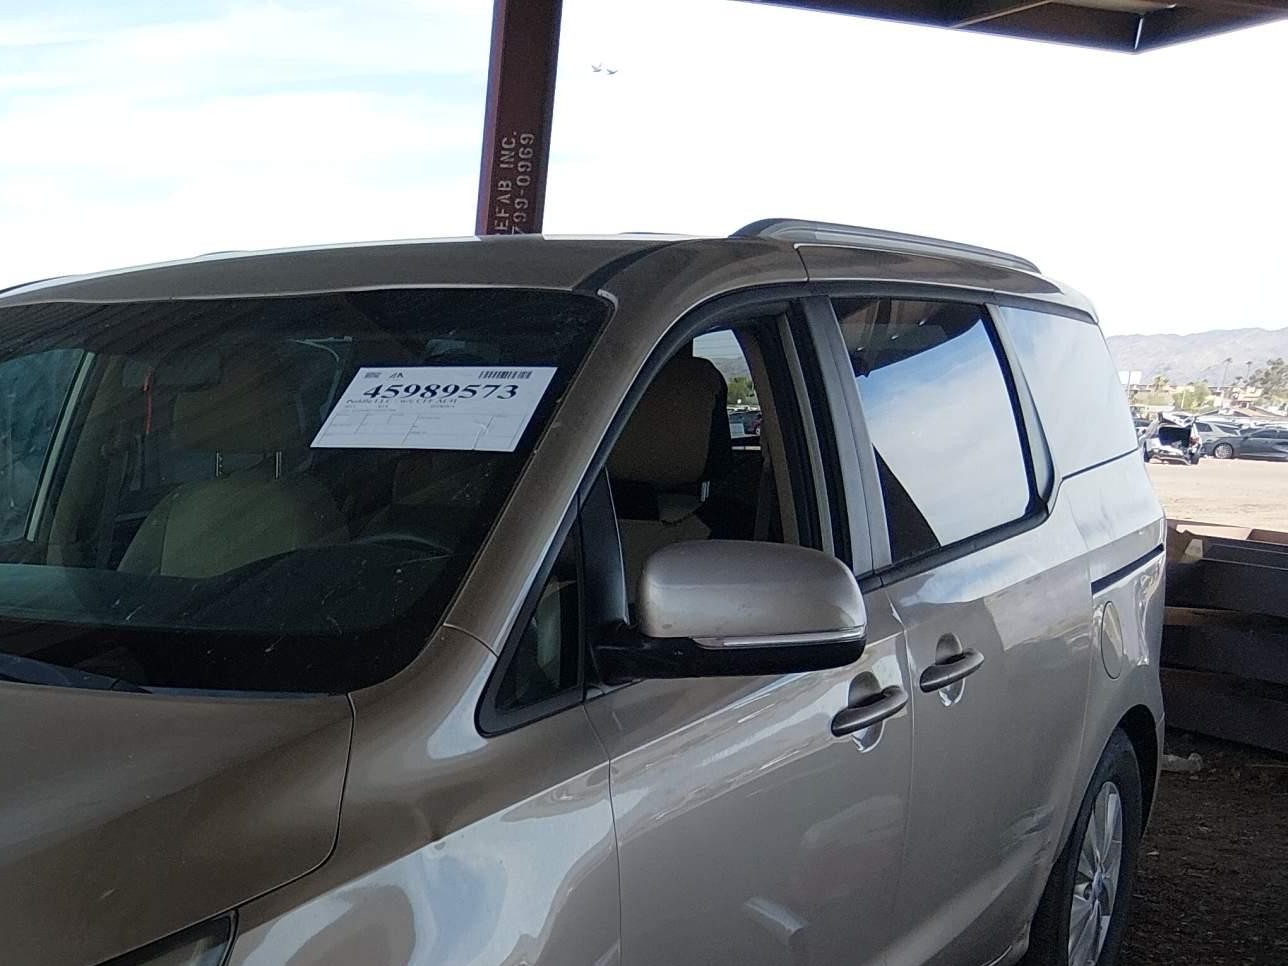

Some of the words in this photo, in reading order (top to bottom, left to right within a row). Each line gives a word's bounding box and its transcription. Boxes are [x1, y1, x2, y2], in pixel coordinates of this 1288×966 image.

[500, 131, 517, 168] INC.
[495, 180, 512, 235] EFAB
[363, 384, 519, 400] 45989573
